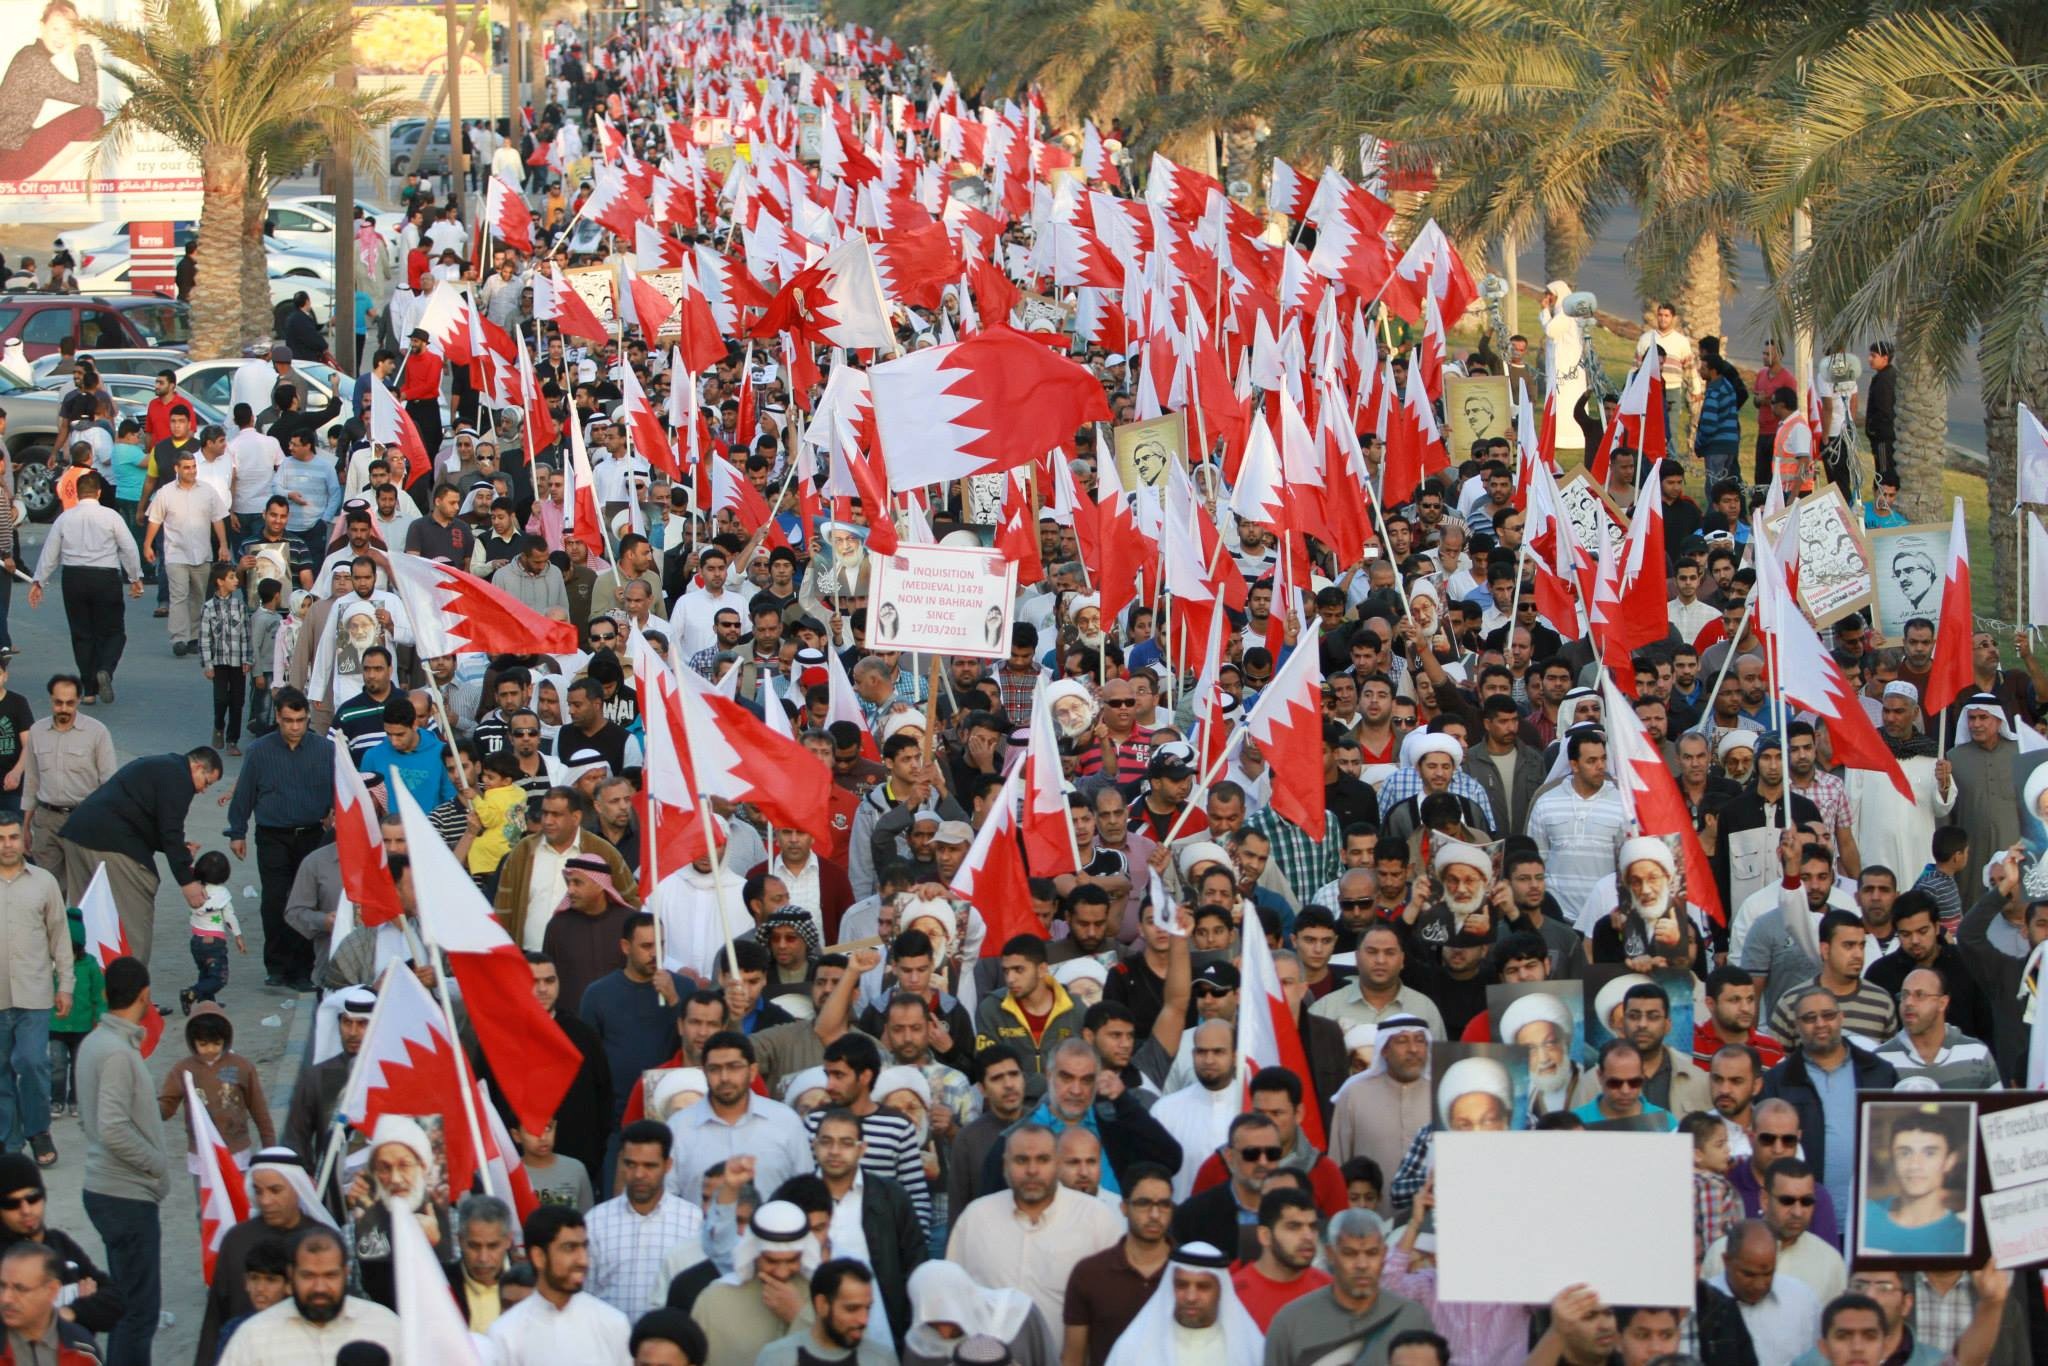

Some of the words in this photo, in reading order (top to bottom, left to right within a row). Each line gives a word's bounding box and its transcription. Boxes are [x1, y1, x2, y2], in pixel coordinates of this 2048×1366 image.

[18, 181, 40, 194] Off
[40, 183, 57, 193] on
[58, 181, 80, 193] ALL
[913, 567, 975, 579] INQUISITION
[902, 580, 955, 593] (MEDIEVAL
[897, 594, 924, 604] NOW
[925, 596, 936, 605] IN
[938, 596, 983, 609] BAHRAIN
[927, 611, 956, 621] SINCE
[911, 623, 968, 636] 17/03/2011
